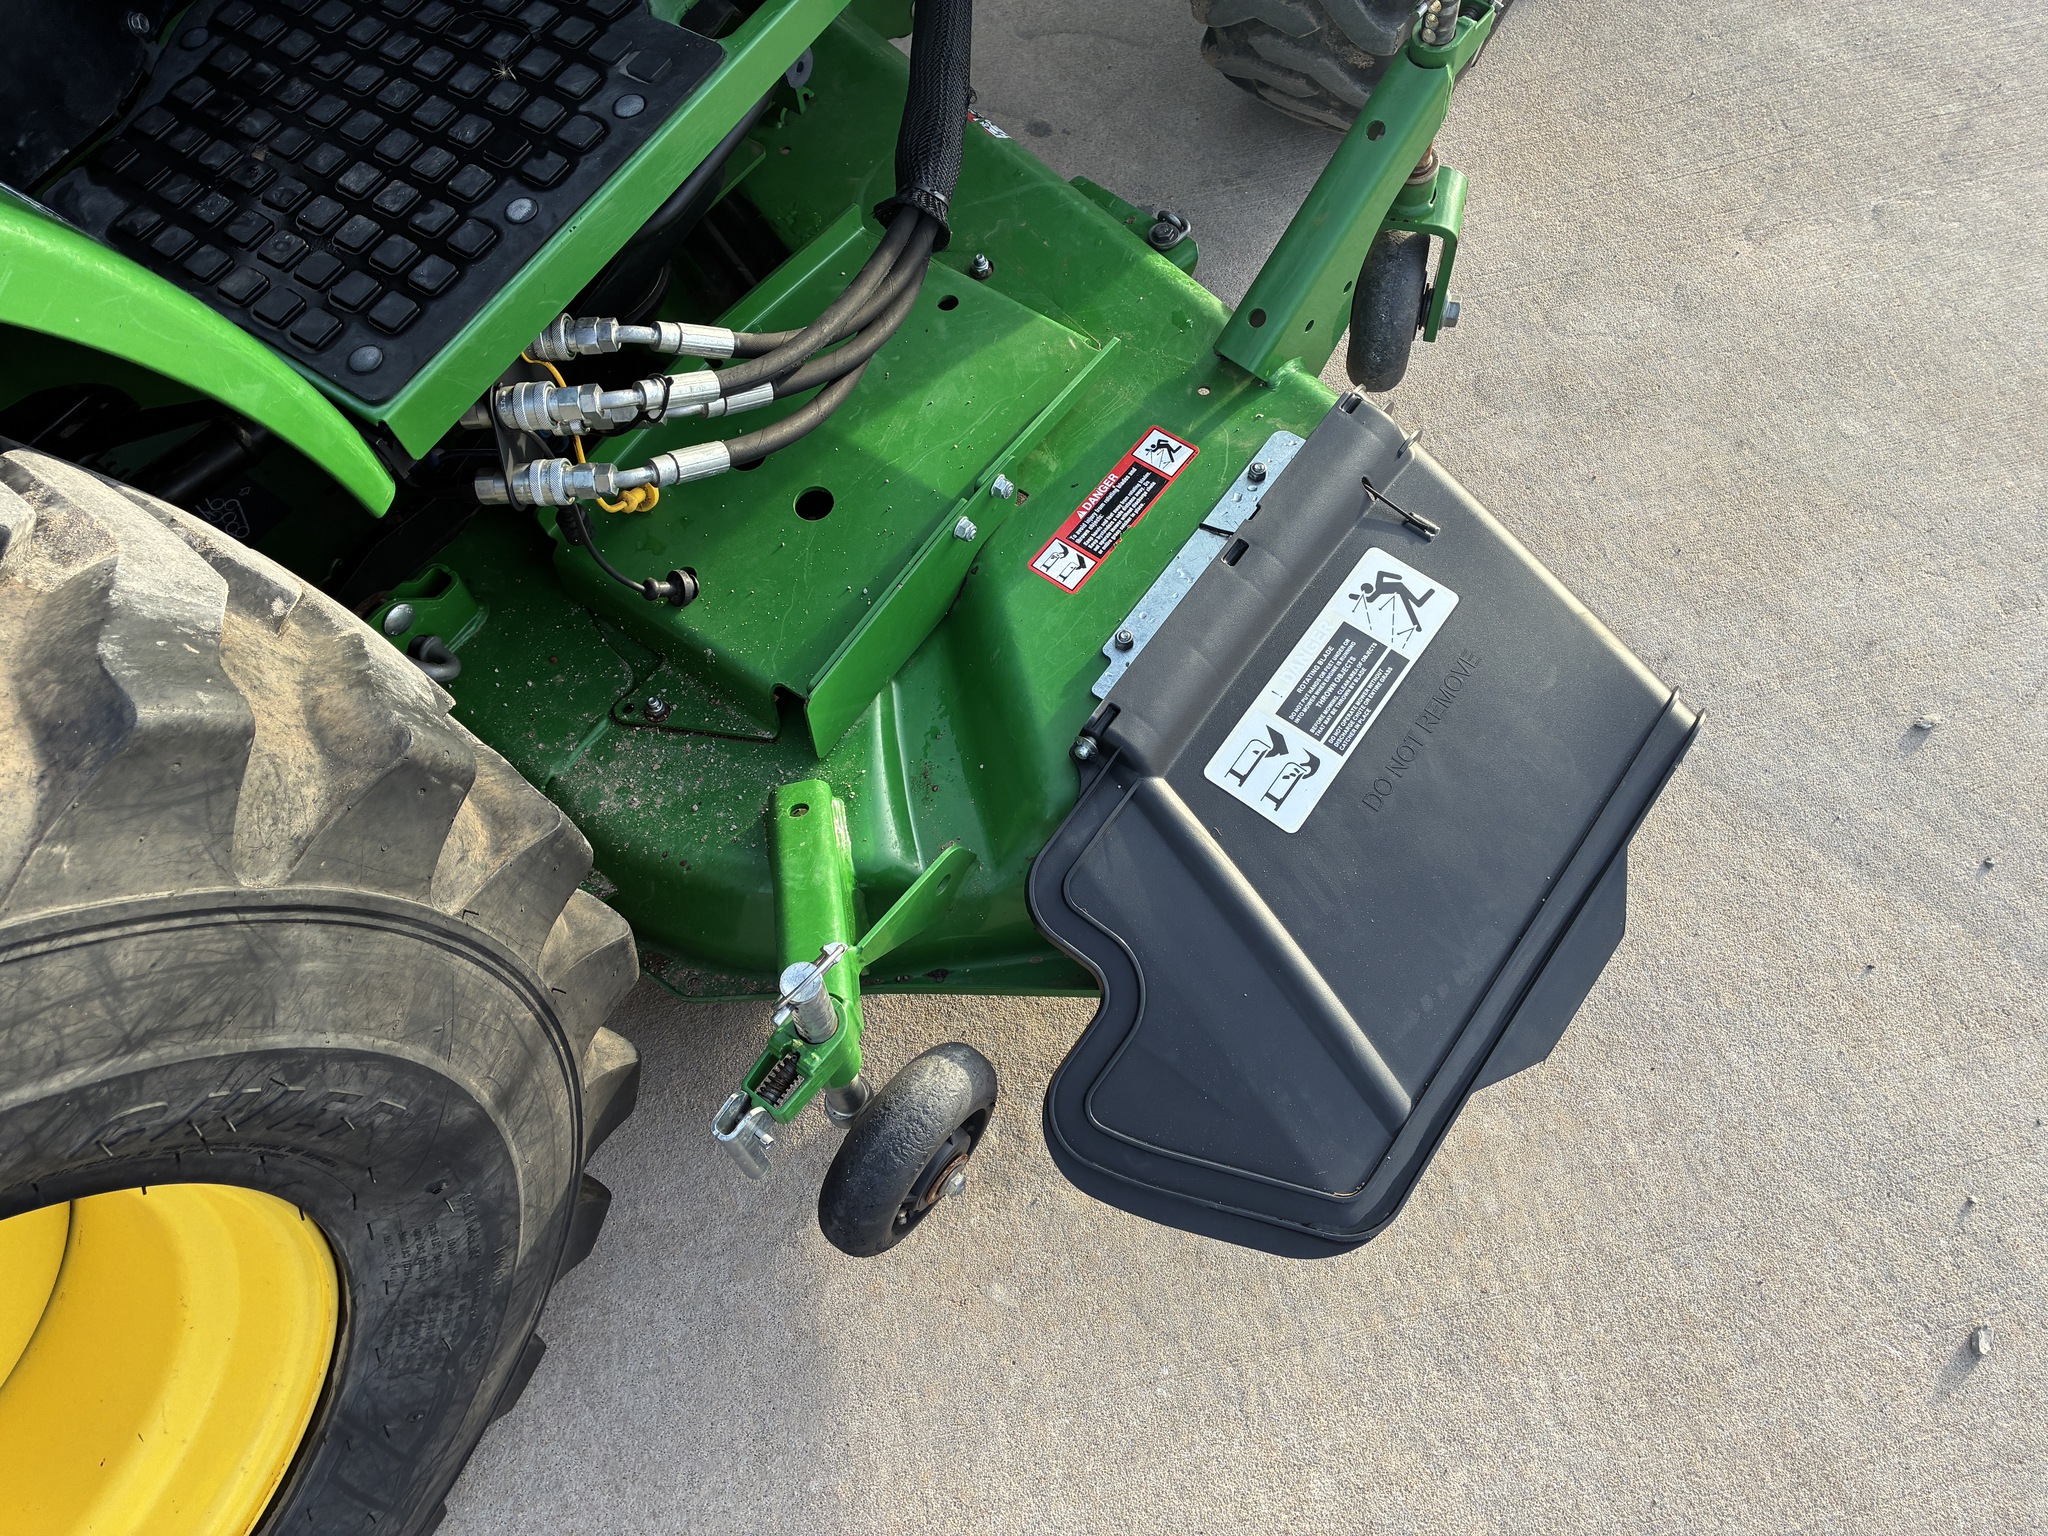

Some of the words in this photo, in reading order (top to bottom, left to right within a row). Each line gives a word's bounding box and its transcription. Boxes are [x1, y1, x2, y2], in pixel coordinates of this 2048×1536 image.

[1081, 472, 1119, 511] DANGER
[1278, 619, 1335, 686] DANGER
[1293, 711, 1304, 723] INTO
[1302, 694, 1317, 712] MOWER
[1314, 681, 1326, 695] WHEN
[1324, 665, 1338, 682] ENGINE
[1339, 641, 1356, 661] RUNNING
[1294, 702, 1303, 712] NOT
[1301, 693, 1310, 703] PUT
[1307, 677, 1321, 694] HANDS
[1323, 659, 1334, 672] FEET
[1332, 644, 1345, 660] UNDER
[1296, 664, 1320, 693] ROTATING
[1317, 645, 1334, 665] BLADE
[1315, 681, 1337, 708] THROWN
[1334, 655, 1356, 683] OBJECTS
[1309, 713, 1325, 733] BEFORE
[1337, 679, 1350, 695] CLEAN
[1347, 666, 1359, 680] AREA
[1360, 642, 1377, 662] OBJECTS
[1314, 724, 1325, 736] THAT
[1323, 714, 1332, 724] MAY
[1335, 688, 1351, 708] THROWN
[1353, 666, 1367, 683] BLADE
[1333, 725, 1343, 736] NOT
[1340, 704, 1358, 726] OPERATE
[1355, 687, 1370, 706] MOWER
[1367, 668, 1384, 689] WITHOUT
[1333, 719, 1355, 747] DISCHARGE
[1352, 704, 1366, 720] CHUTE
[1368, 681, 1382, 698] ENTIRE
[1379, 666, 1393, 682] GRASS
[1338, 728, 1357, 750] CATCHER
[1357, 707, 1371, 724] PLACE
[1362, 777, 1393, 812] DO
[1385, 731, 1425, 779] NOT
[1415, 648, 1481, 734] REMOVE
